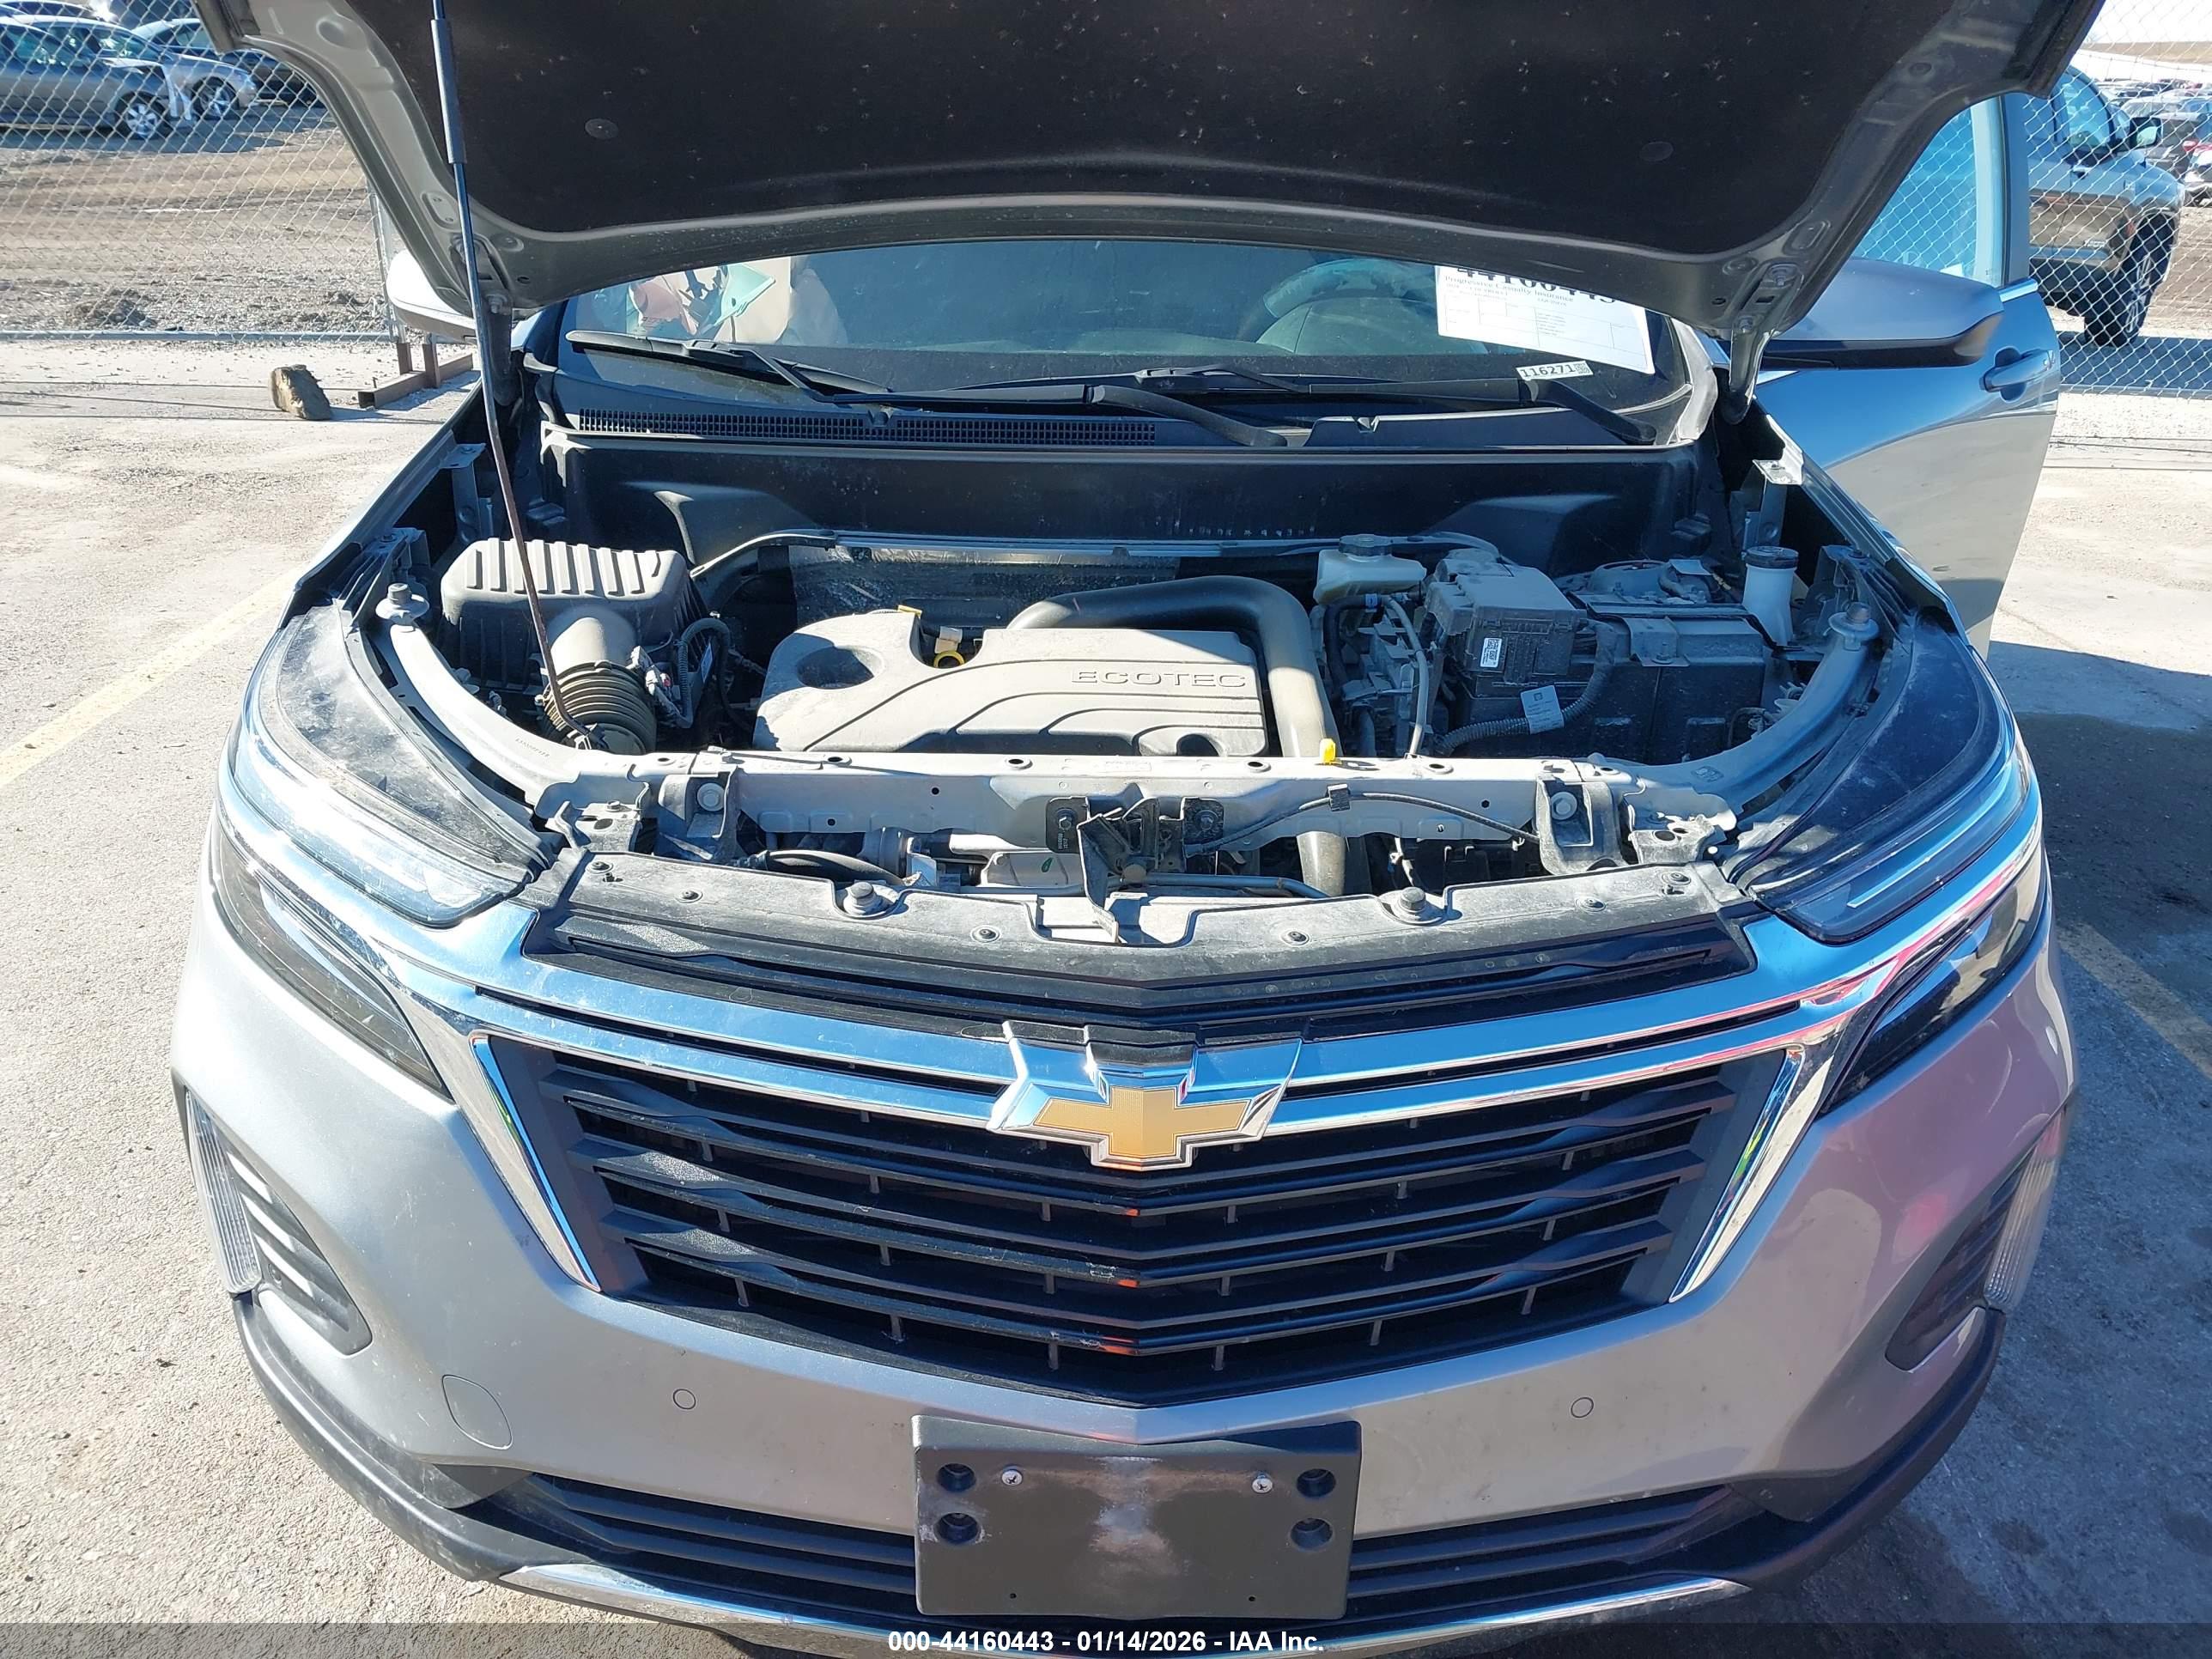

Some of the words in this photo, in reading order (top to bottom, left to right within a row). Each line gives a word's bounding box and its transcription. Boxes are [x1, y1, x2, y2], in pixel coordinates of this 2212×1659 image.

[1445, 276, 1493, 288] Progressive
[1495, 281, 1531, 295] Casualty
[1534, 290, 1574, 302] Insurance
[1519, 363, 1577, 377] 116271
[1072, 670, 1246, 688] ECOTEC
